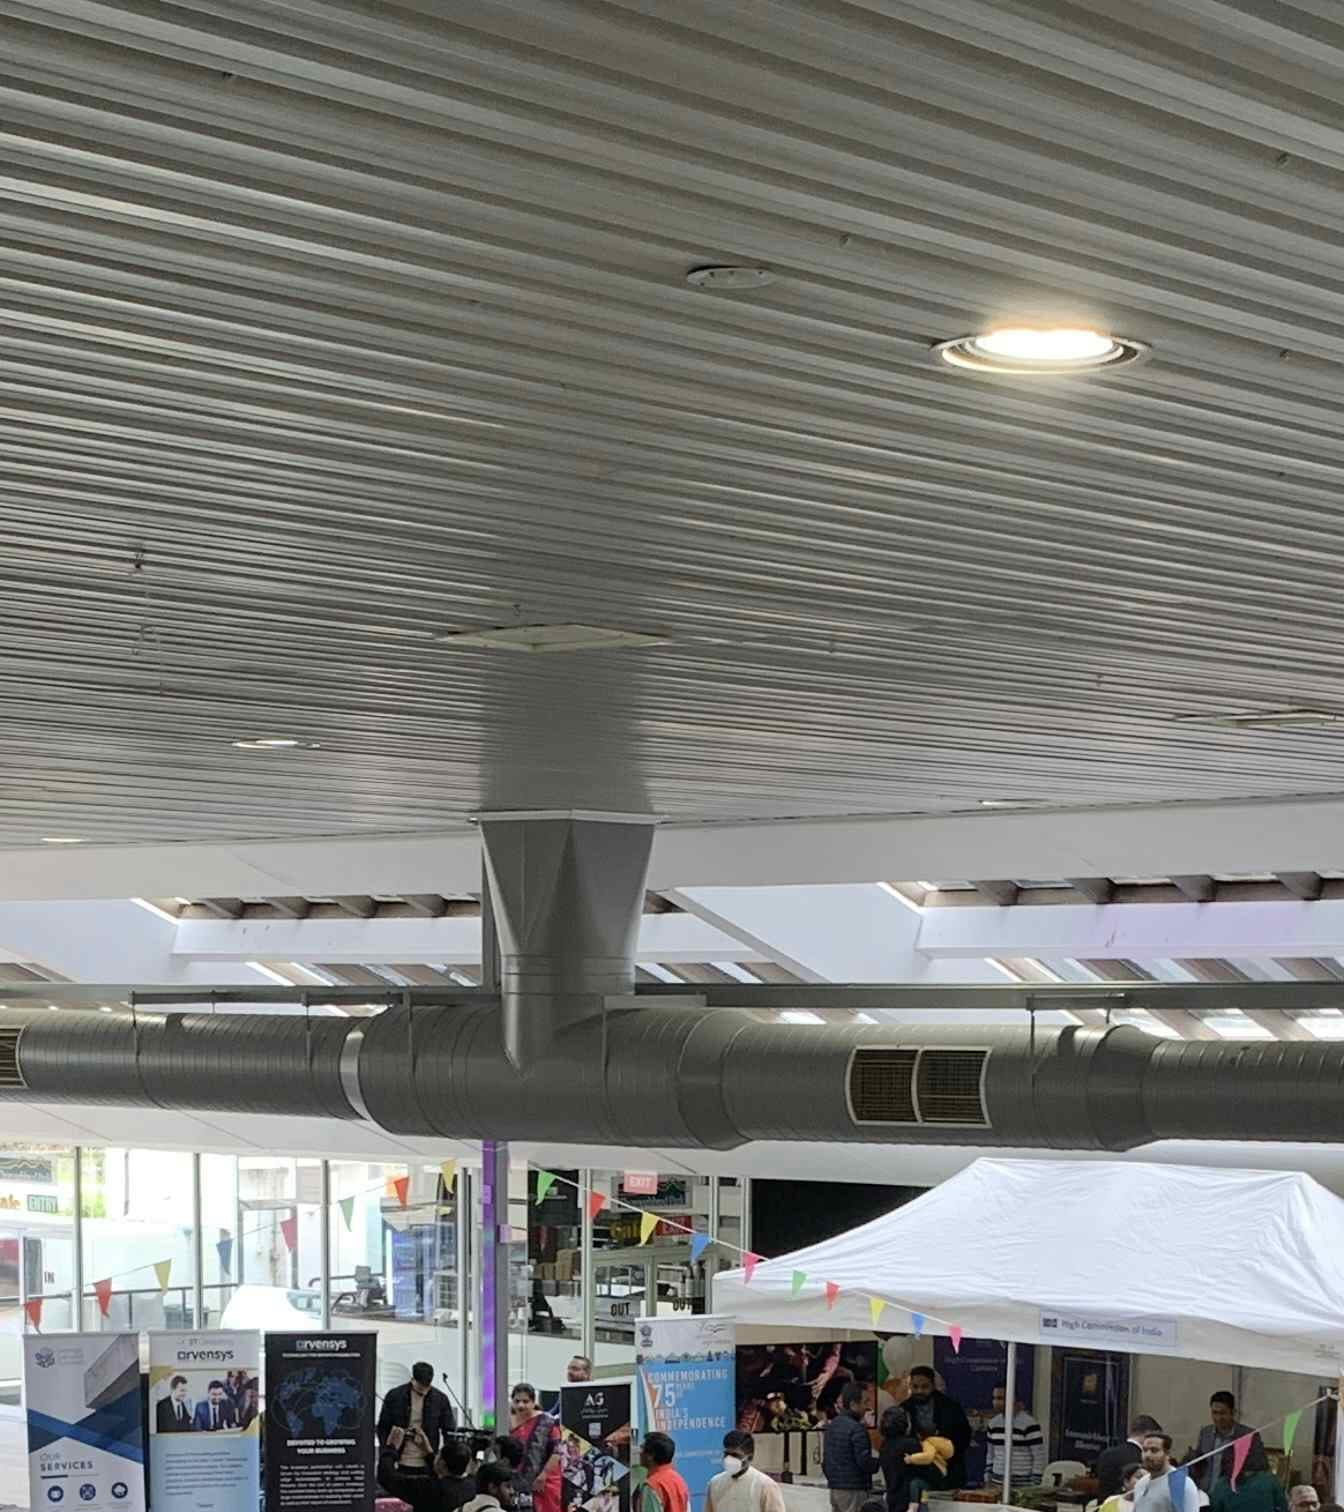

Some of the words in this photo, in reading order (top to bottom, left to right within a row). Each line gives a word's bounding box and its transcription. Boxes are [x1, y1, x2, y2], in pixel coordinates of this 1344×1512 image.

[629, 1176, 653, 1187] EXIT
[610, 1302, 630, 1316] OUT
[1061, 1319, 1080, 1331] High
[1081, 1321, 1130, 1333] Commission
[1142, 1327, 1163, 1337] India
[647, 1368, 729, 1384] COMMEMORATING
[653, 1383, 676, 1409] 75
[656, 1417, 727, 1432] INDEPENDENCE
[40, 1460, 94, 1472] SERVICES
